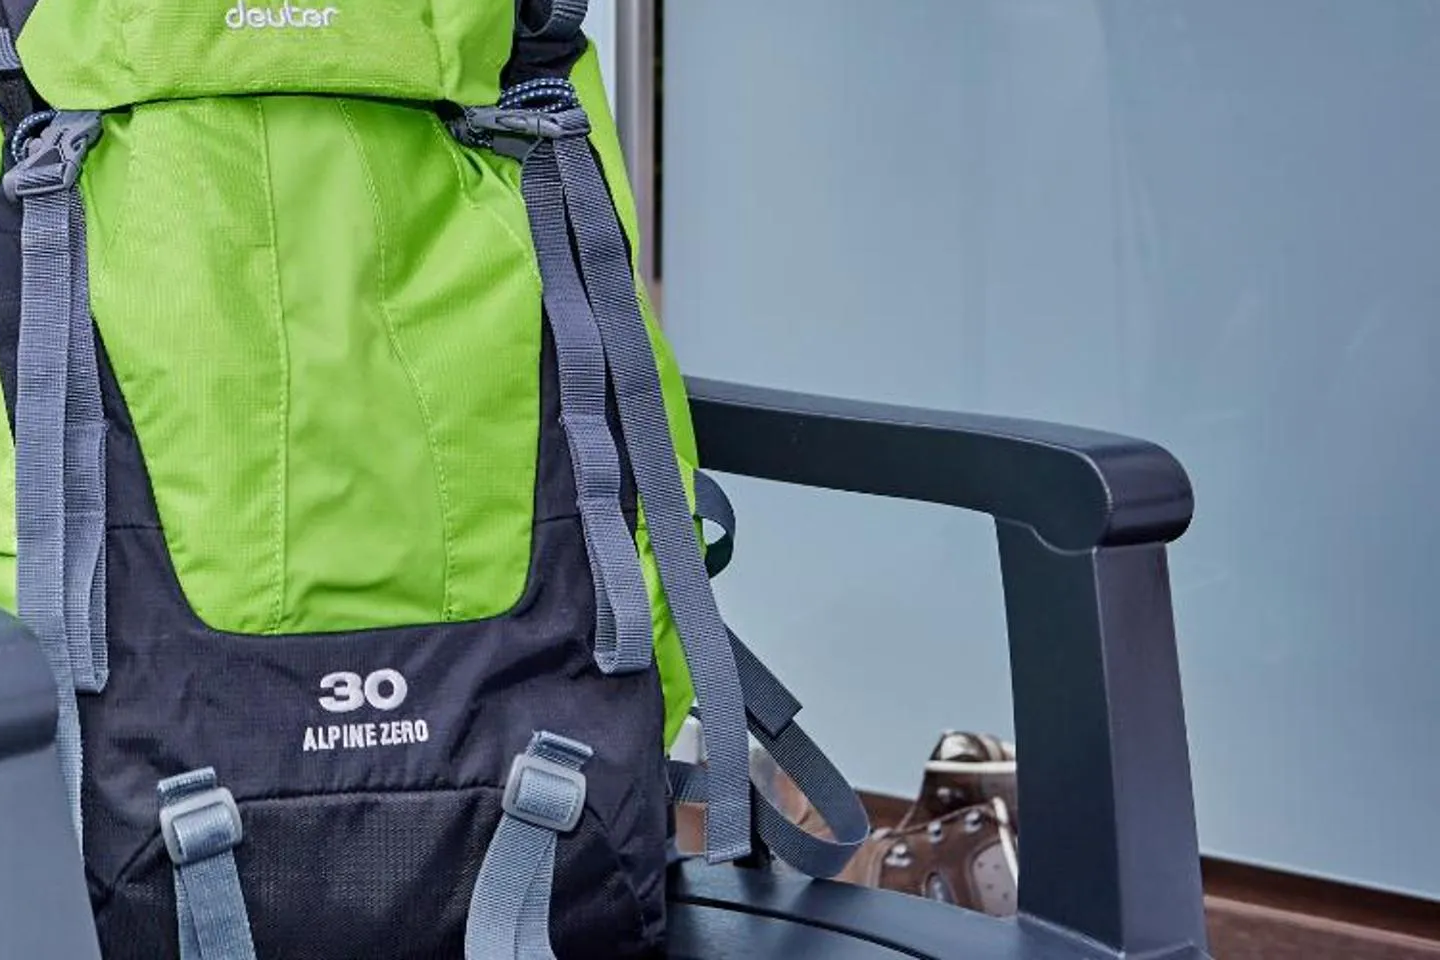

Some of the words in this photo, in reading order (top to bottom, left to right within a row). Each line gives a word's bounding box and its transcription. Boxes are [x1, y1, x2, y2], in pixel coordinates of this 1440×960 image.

[318, 667, 408, 713] 30
[302, 724, 377, 752] ALPINE
[379, 719, 429, 746] ZERO
